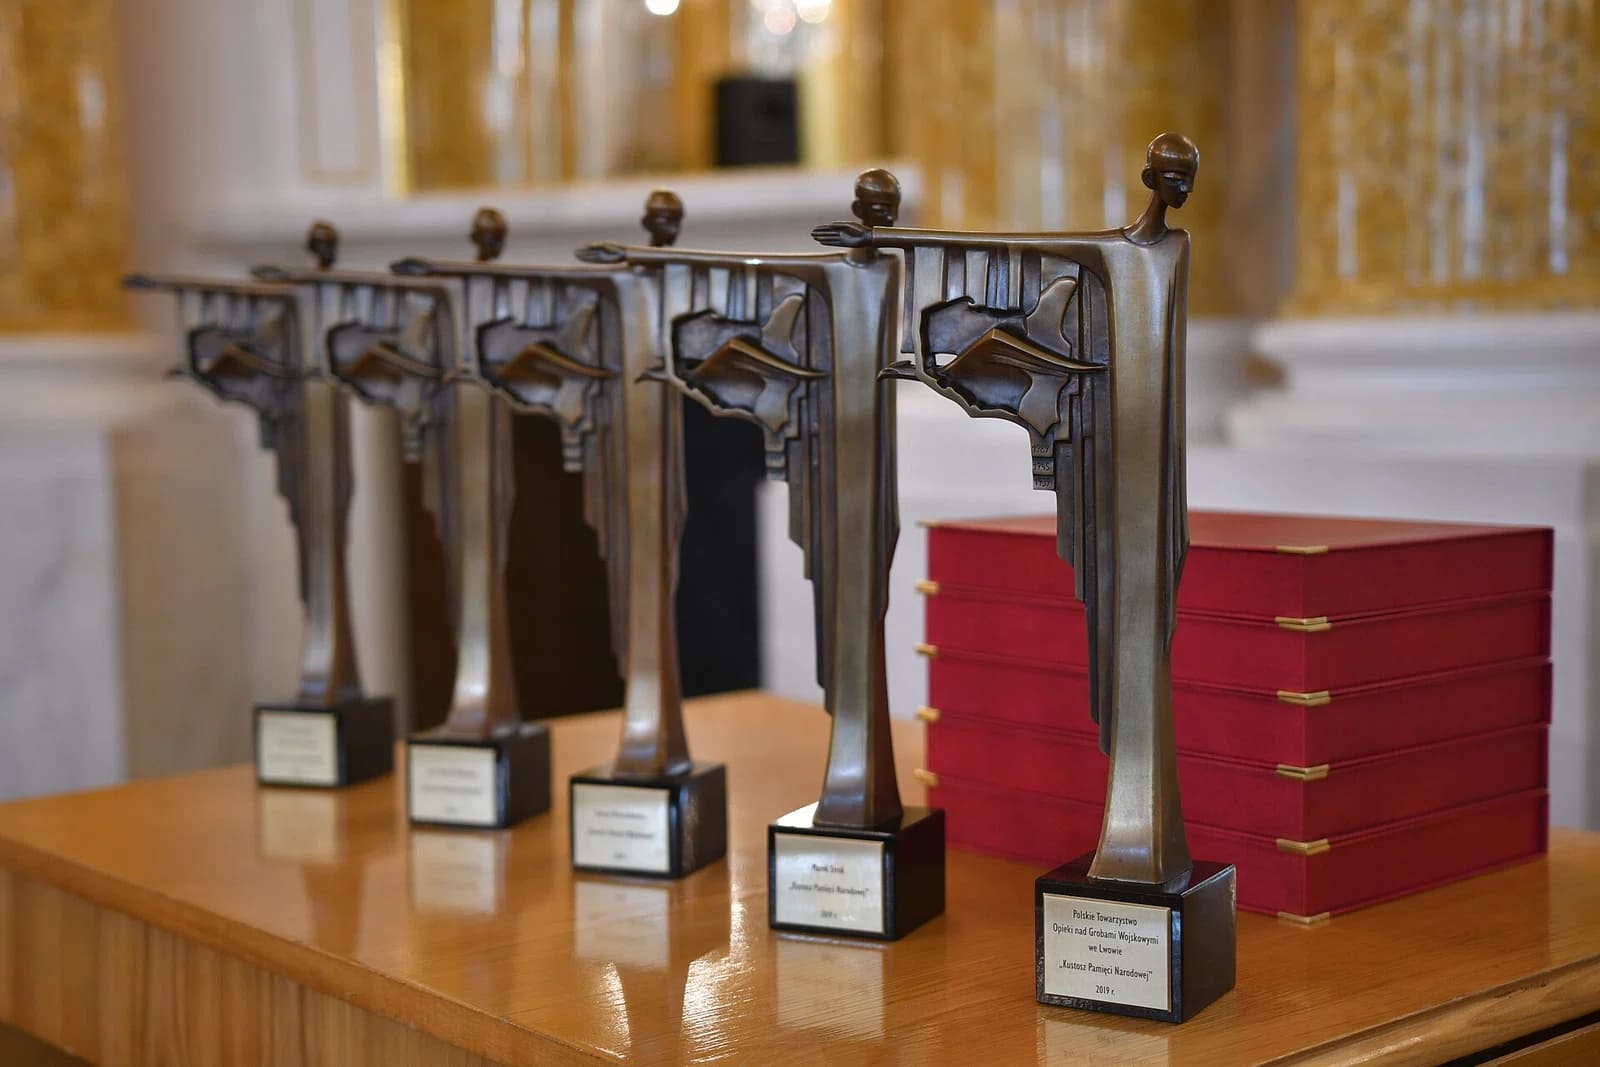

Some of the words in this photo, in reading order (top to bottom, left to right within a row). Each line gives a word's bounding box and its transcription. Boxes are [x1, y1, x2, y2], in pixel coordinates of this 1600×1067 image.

[1072, 909, 1095, 921] Polskie
[1096, 912, 1138, 927] Towarzystwo
[1052, 922, 1074, 935] Opieki
[1075, 925, 1087, 936] nad
[1088, 927, 1117, 939] Grobami
[1118, 930, 1159, 946] Wojskowymi
[1088, 945, 1098, 953] we
[1099, 943, 1123, 956] Lwowie
[1088, 962, 1113, 976] Pamięci
[1095, 984, 1110, 995] 2019
